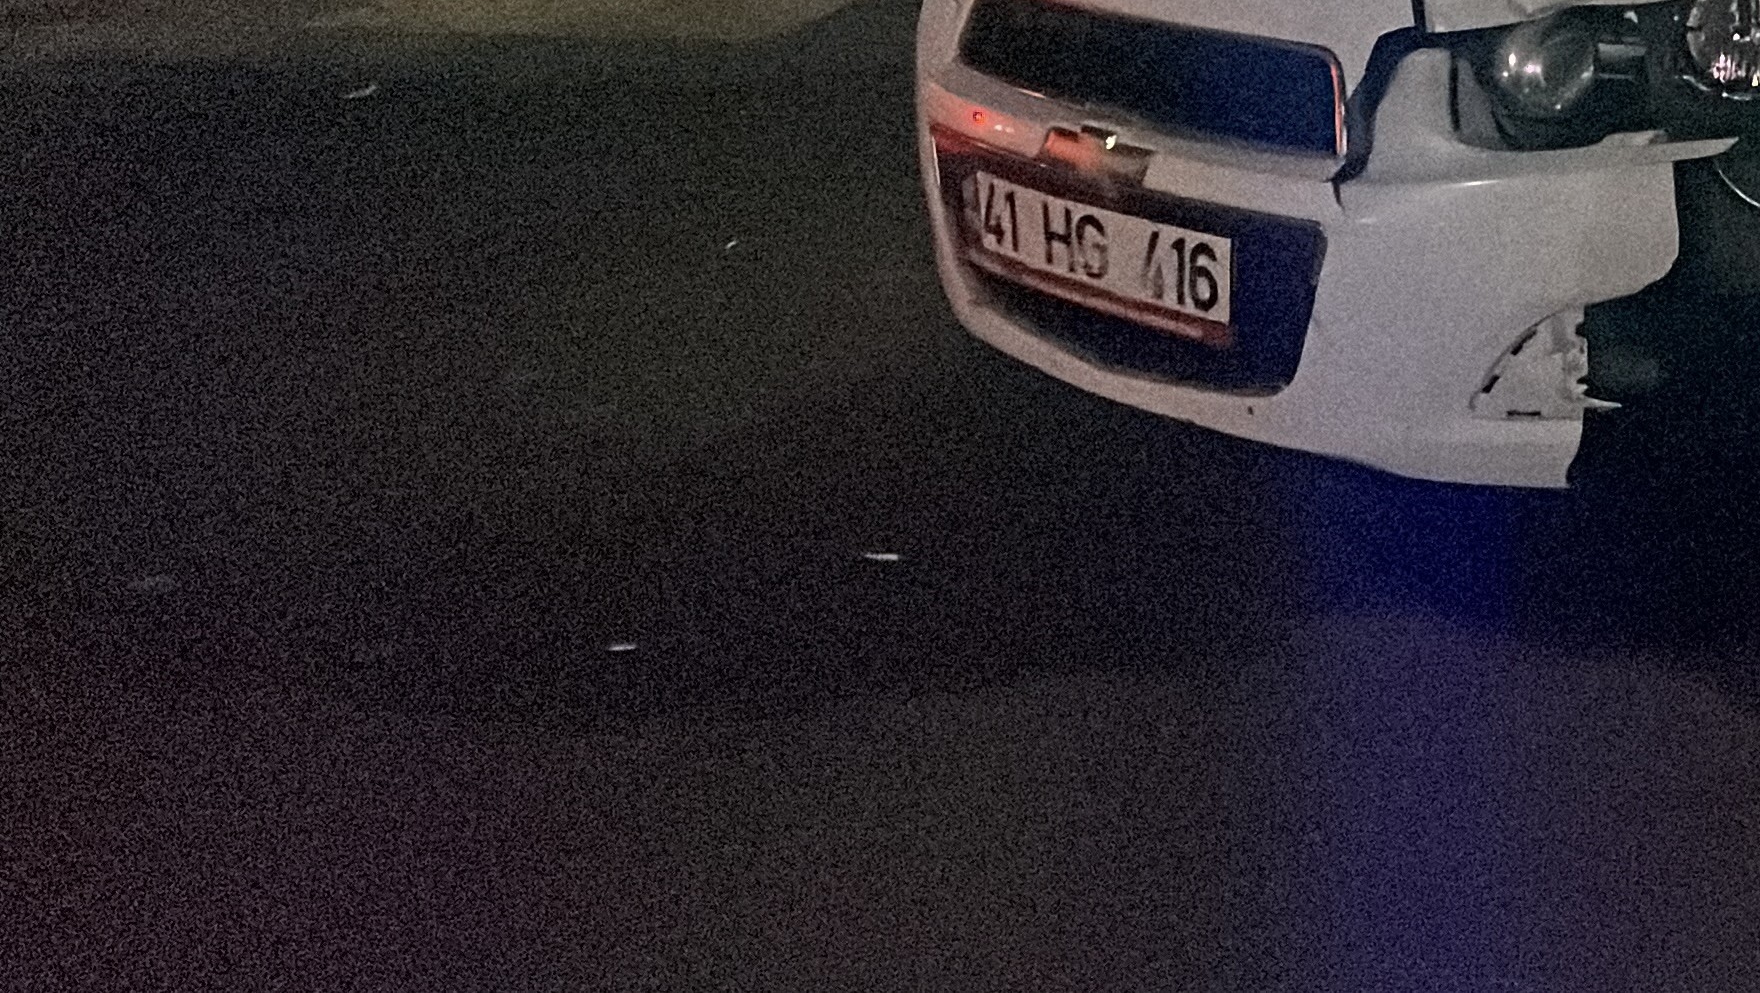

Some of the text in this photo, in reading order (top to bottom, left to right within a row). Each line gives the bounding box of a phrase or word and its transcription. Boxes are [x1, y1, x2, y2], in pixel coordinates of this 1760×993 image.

[984, 182, 1219, 313] 41 HG 416
